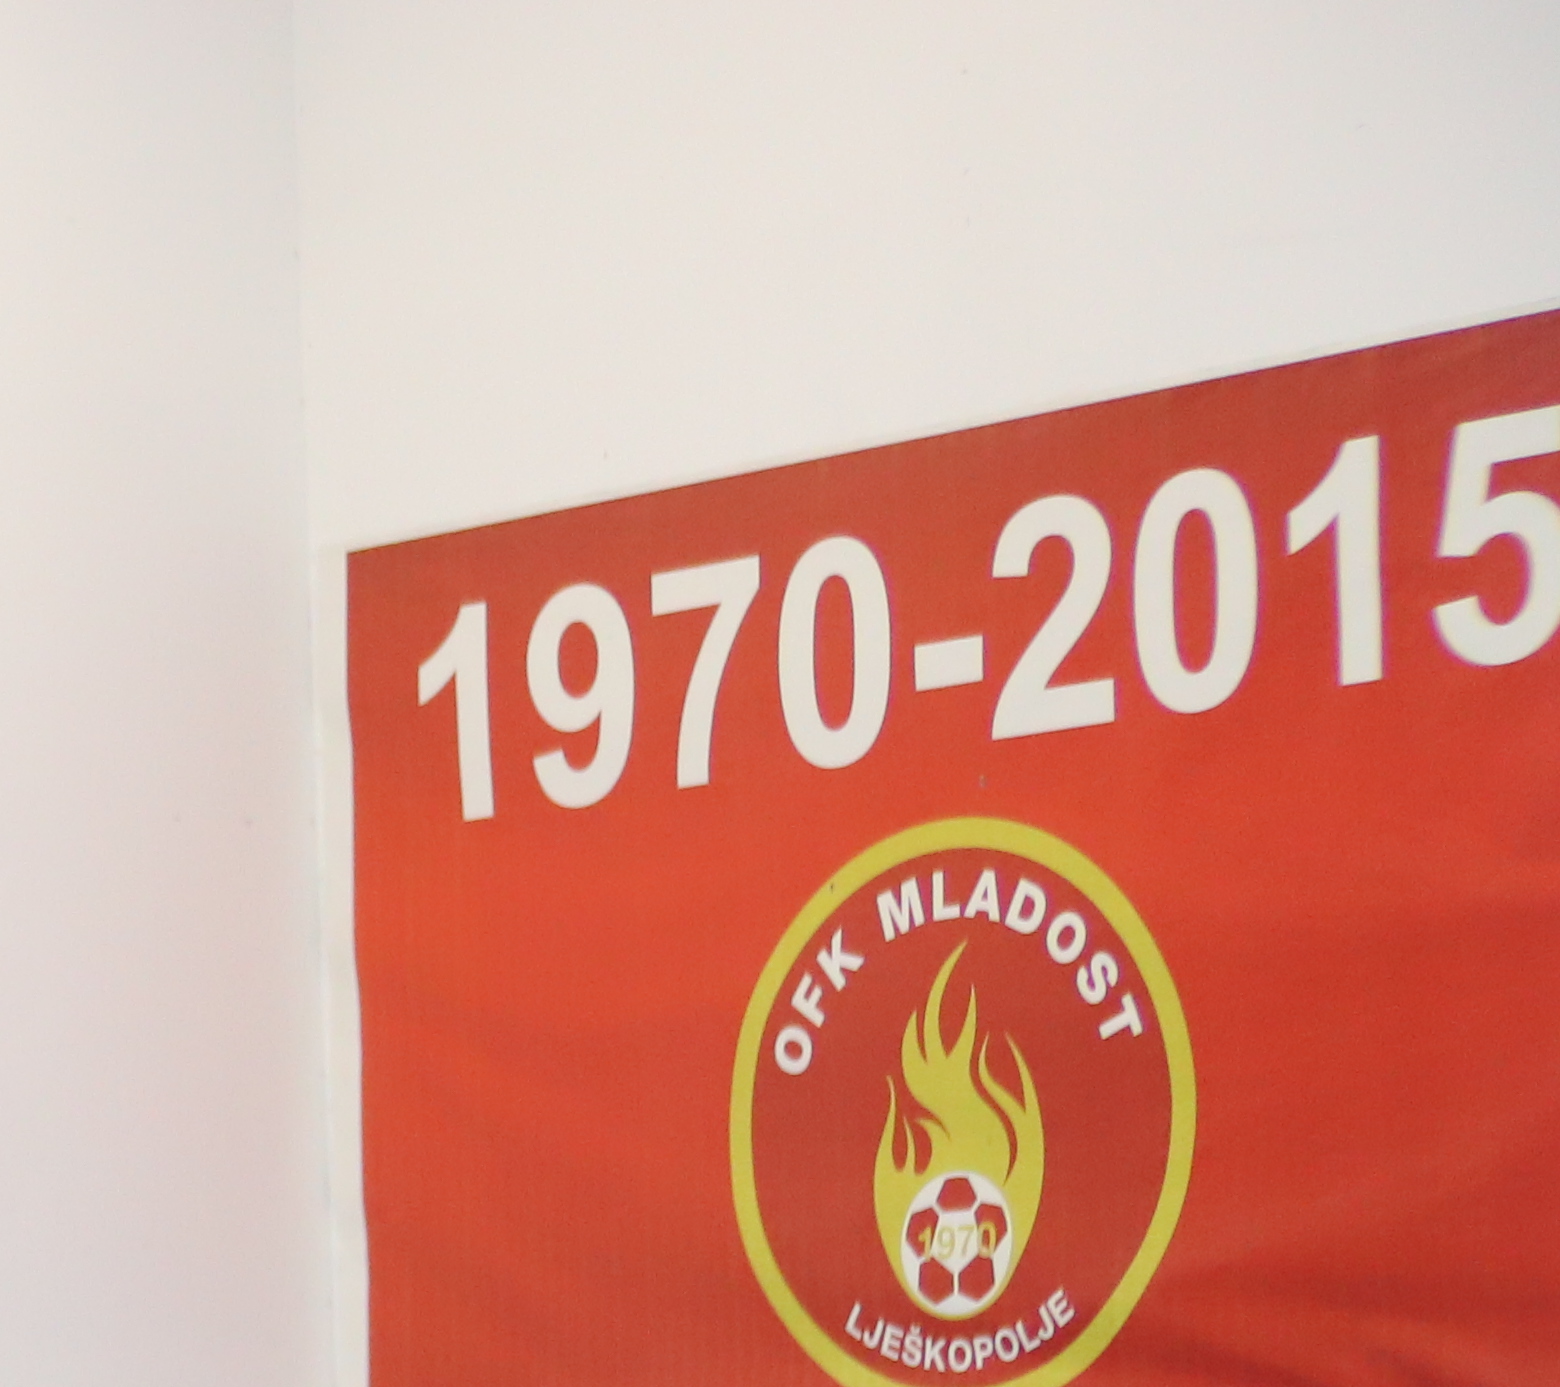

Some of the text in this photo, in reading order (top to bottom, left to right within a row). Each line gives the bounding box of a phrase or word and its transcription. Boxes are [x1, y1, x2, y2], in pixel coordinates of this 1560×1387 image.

[416, 400, 1560, 823] 1970-2015
[773, 868, 1144, 1076] OFK MLADOST
[917, 1220, 998, 1264] 1970
[843, 1287, 1077, 1375] LJEŠKOPOLJE
